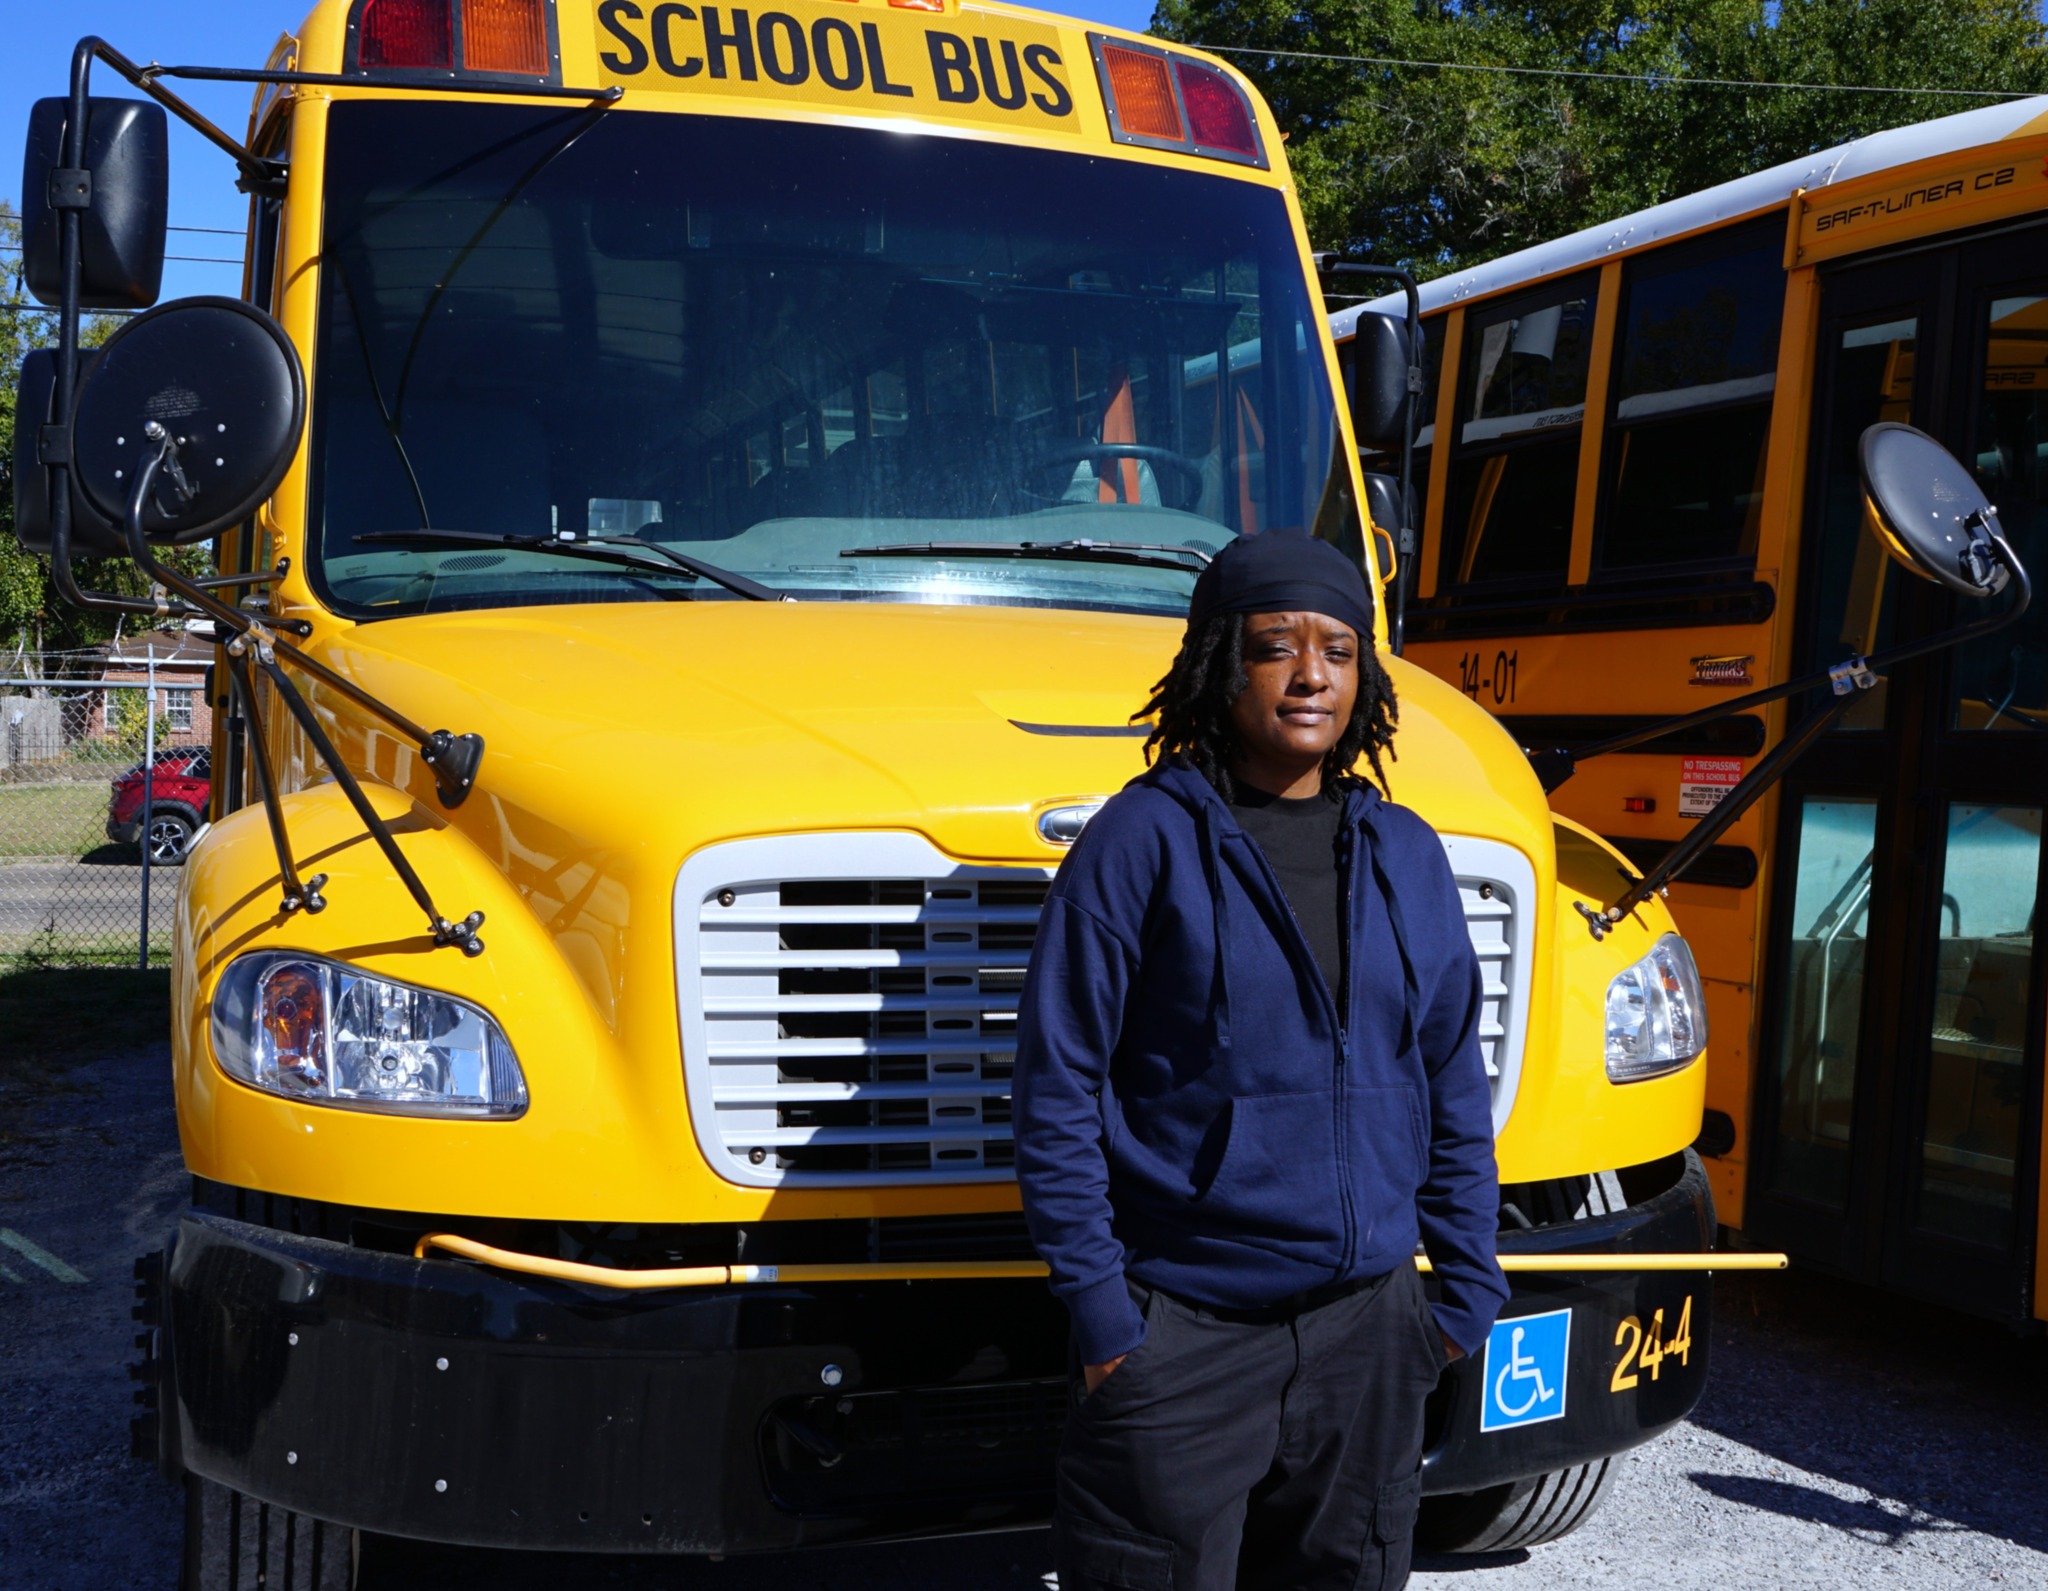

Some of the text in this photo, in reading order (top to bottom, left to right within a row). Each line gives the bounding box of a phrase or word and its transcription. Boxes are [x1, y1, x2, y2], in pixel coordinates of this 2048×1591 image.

[598, 0, 1073, 117] SCHOOL BUS
[1816, 167, 2015, 232] SAF-T-LINER C2
[1459, 649, 1518, 705] 14-01
[1683, 760, 1741, 771] NO TRESPASSING
[1683, 772, 1740, 782] ON THIS SCHOOL BUS
[1610, 1295, 1692, 1393] 24-4
